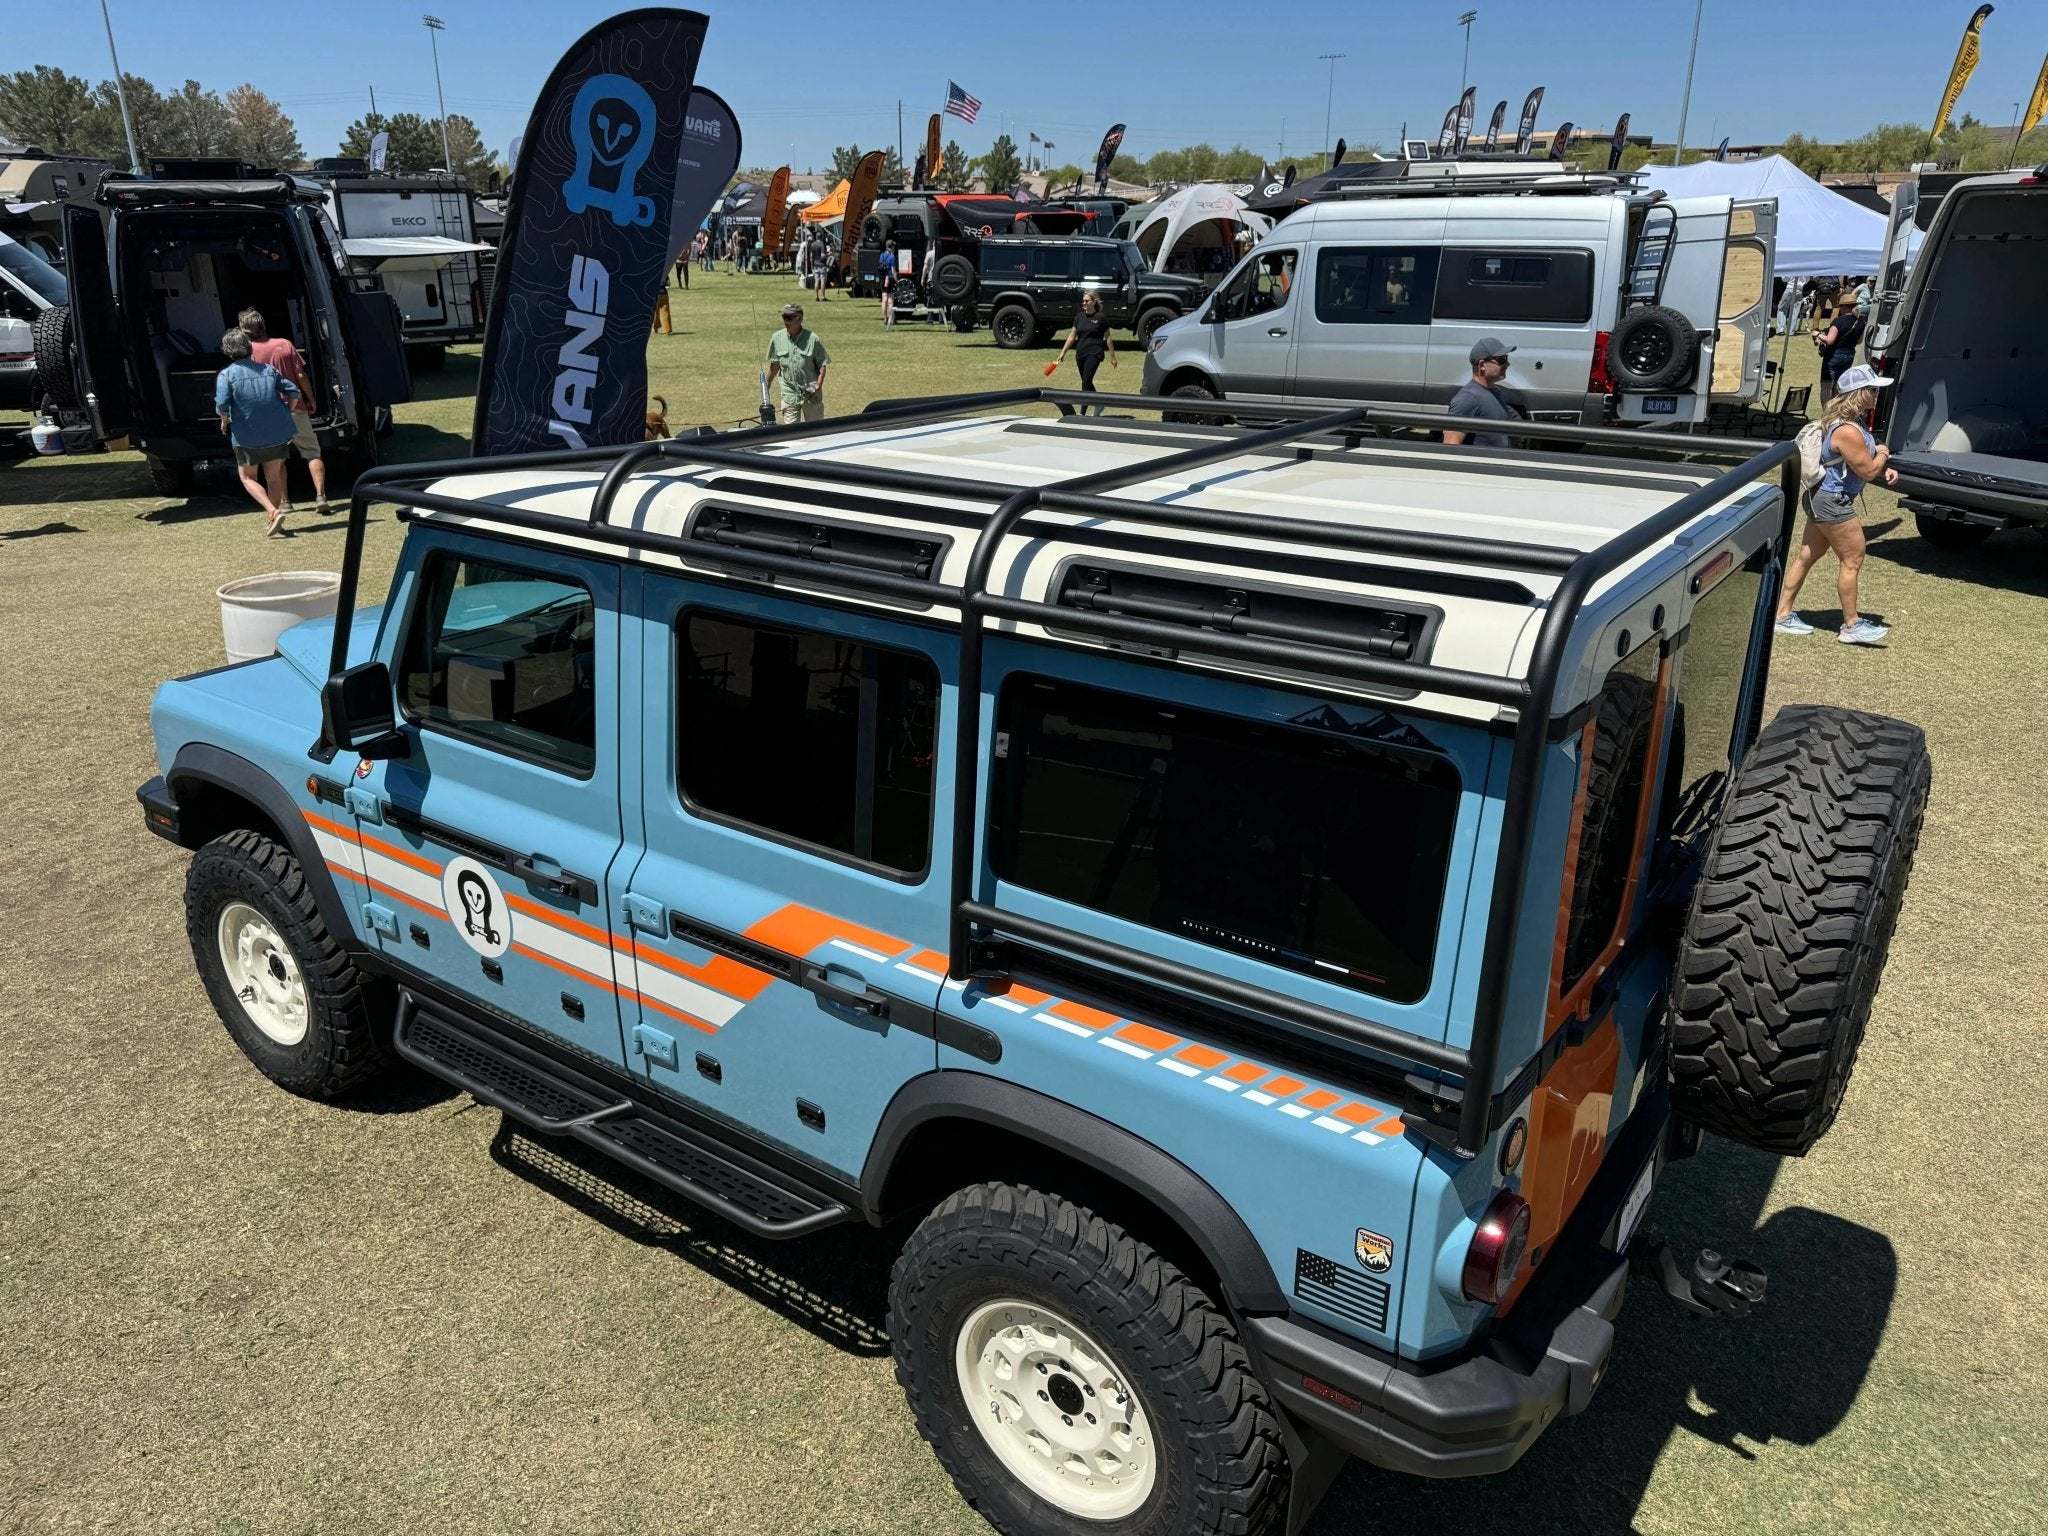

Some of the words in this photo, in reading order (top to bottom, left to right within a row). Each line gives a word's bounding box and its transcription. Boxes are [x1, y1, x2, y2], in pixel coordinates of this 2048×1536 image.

[685, 115, 720, 138] VANS
[391, 216, 427, 226] EKKO
[1361, 1236, 1387, 1250] Works
